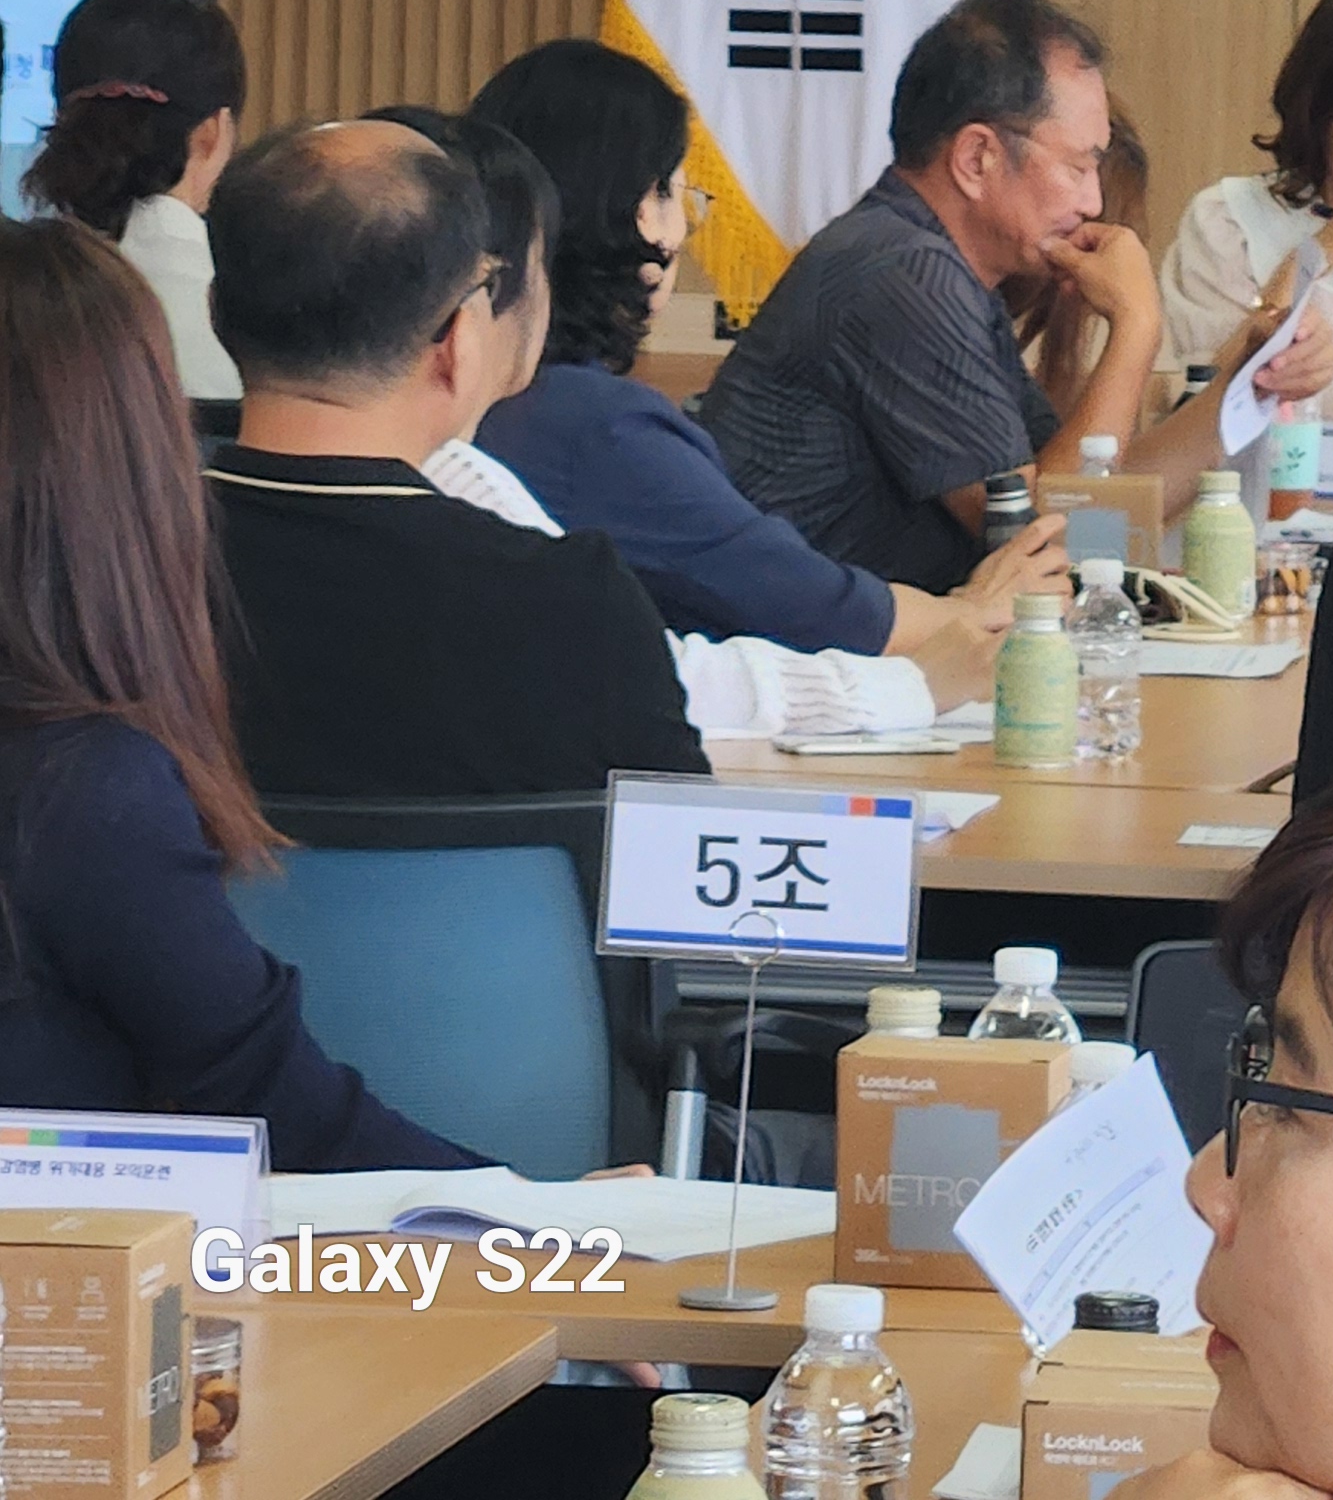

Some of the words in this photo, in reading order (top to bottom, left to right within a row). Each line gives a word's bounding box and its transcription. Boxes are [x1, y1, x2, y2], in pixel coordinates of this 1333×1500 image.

[694, 833, 830, 914] 5조
[854, 1173, 981, 1208] METRO
[1043, 1432, 1143, 1453] LocknLock
